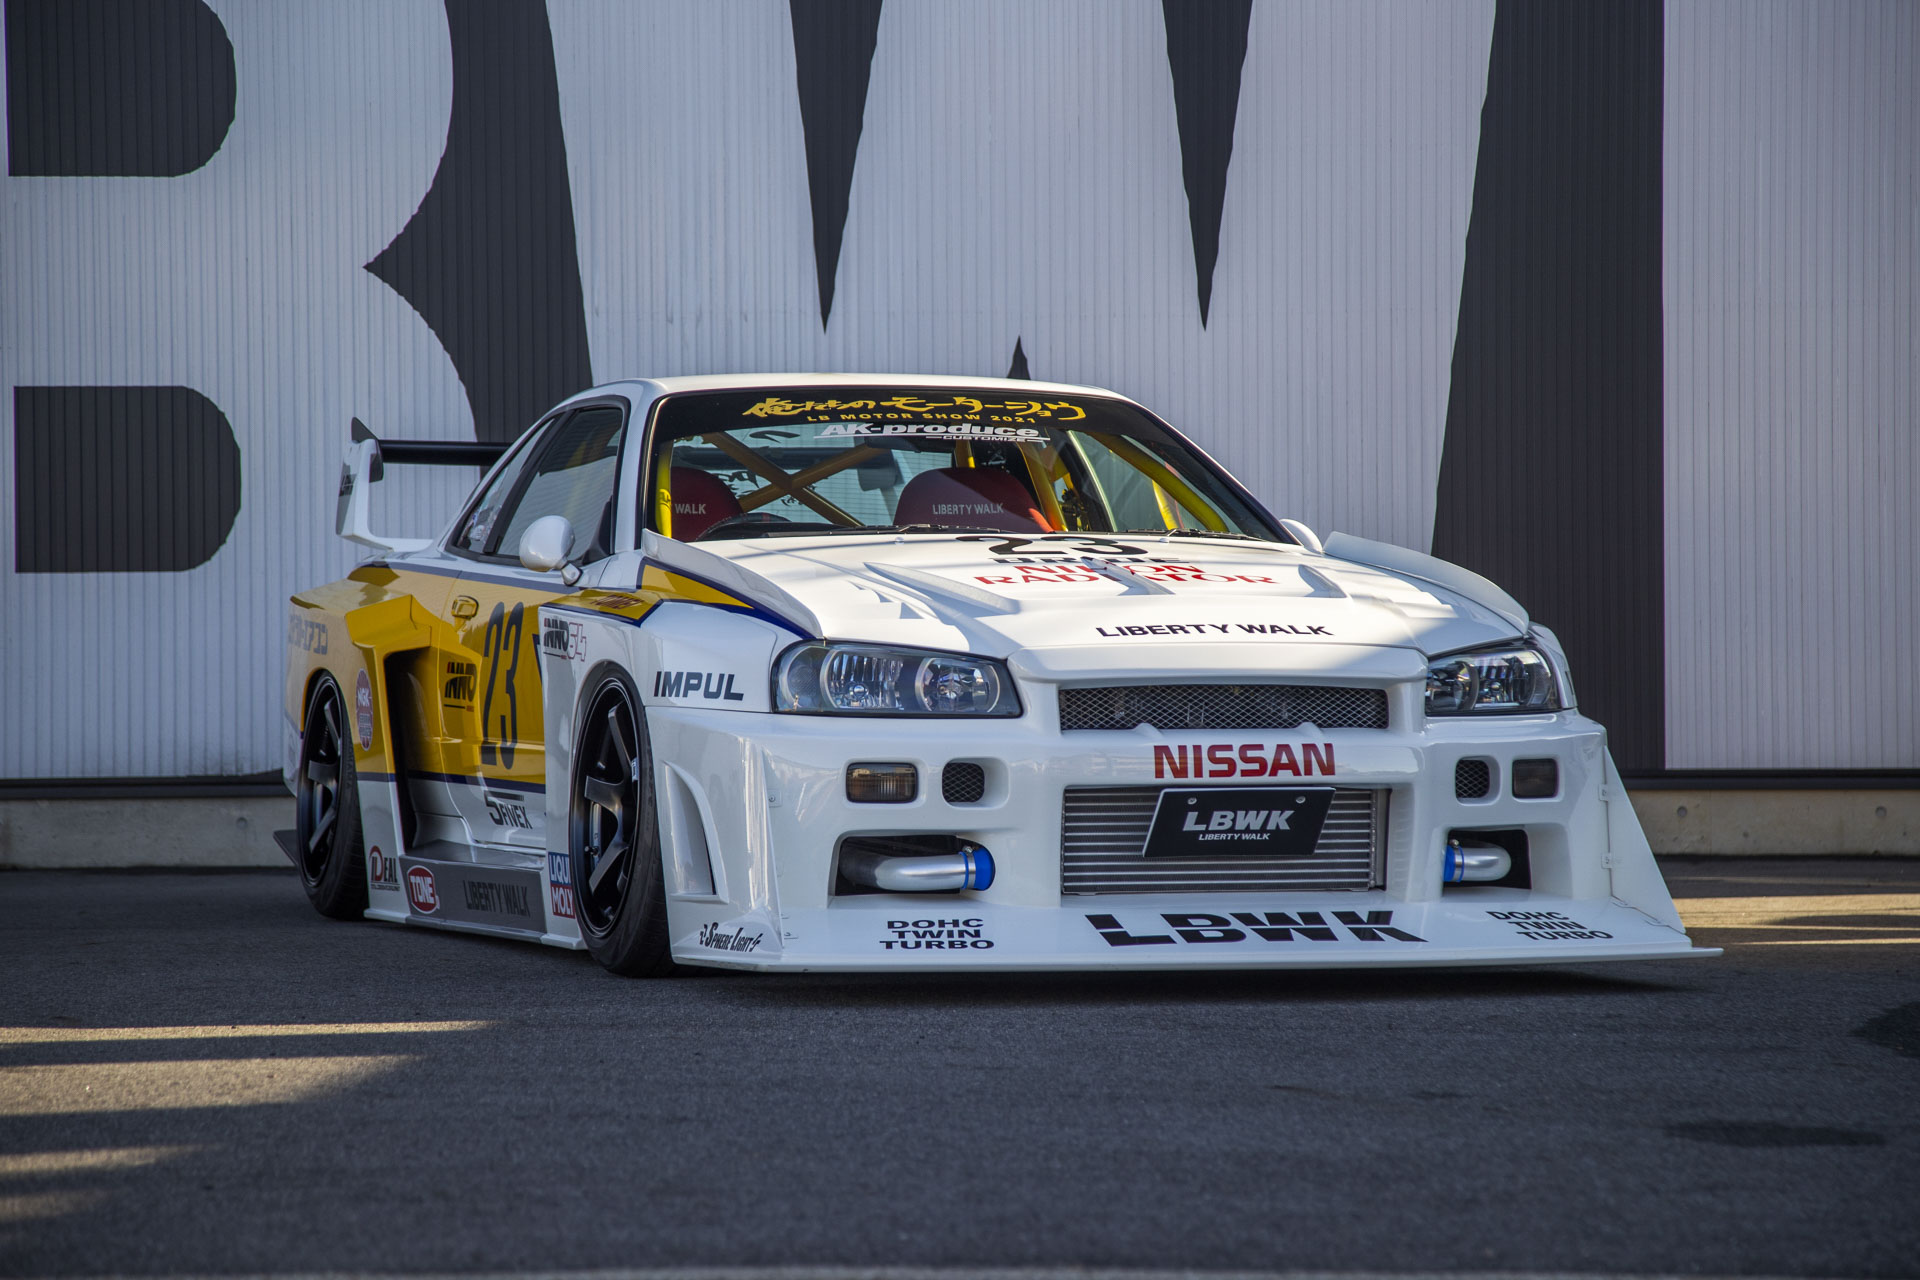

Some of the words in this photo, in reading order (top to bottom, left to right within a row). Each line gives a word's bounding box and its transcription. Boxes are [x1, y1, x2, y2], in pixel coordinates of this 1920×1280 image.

[990, 415, 1036, 424] 2021
[820, 422, 1040, 437] AK-produce
[675, 503, 707, 515] WALK
[932, 504, 972, 515] LIBERTY
[976, 503, 1004, 514] WALK
[956, 536, 1148, 555] 23
[1096, 624, 1230, 637] LIBERTY
[1236, 624, 1333, 635] WALK
[481, 601, 525, 770] 23
[653, 671, 745, 701] IMPUL
[1154, 743, 1336, 779] NISSAN
[1182, 810, 1295, 832] LBWK
[1198, 833, 1241, 841] LIBERTY
[410, 875, 435, 905] TONE
[463, 880, 503, 914] LIBERTY
[501, 883, 531, 918] WALK
[551, 886, 575, 917] MOLY
[1486, 911, 1570, 920] DOHC
[887, 918, 984, 929] DOHC
[1507, 921, 1588, 930] TWIN
[892, 929, 981, 939] TWIN
[1516, 930, 1614, 941] TURBO
[879, 939, 995, 950] TURBO
